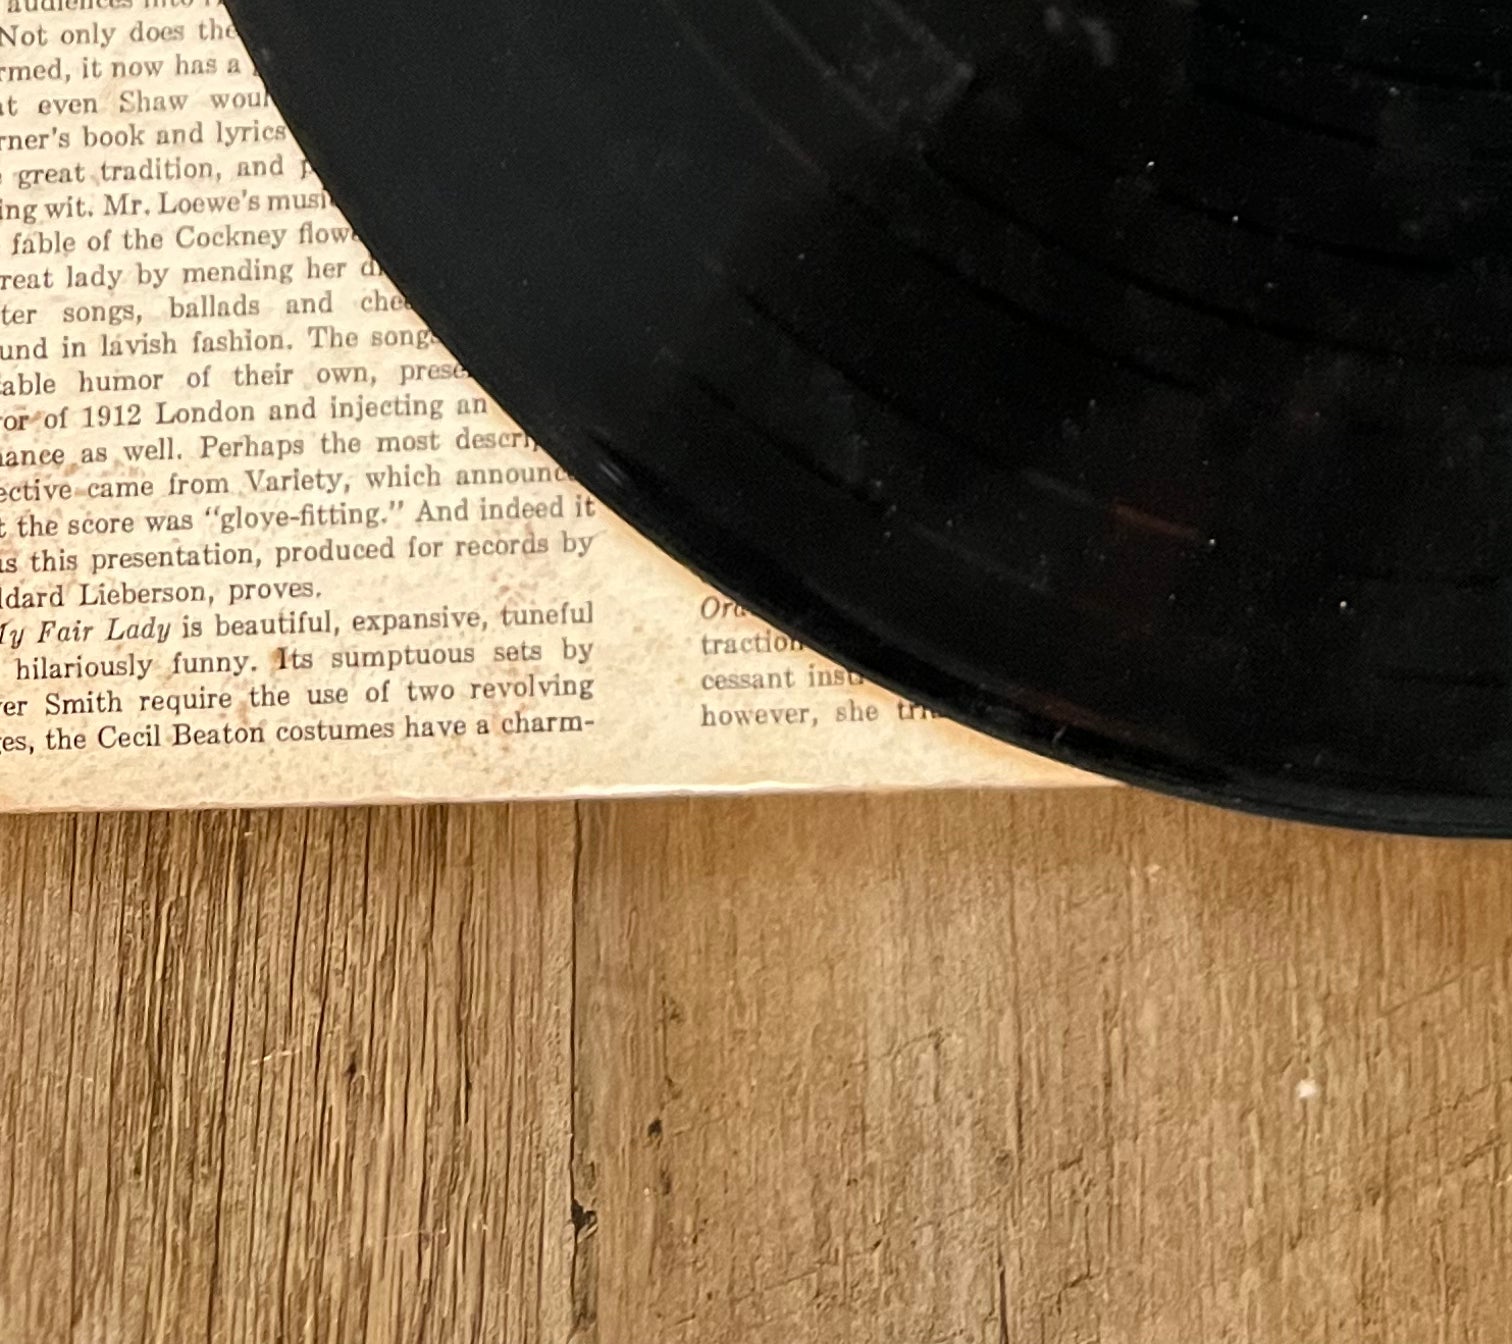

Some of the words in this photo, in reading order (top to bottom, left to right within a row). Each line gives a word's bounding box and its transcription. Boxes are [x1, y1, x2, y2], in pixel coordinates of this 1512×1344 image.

[60, 21, 116, 49] only
[129, 20, 184, 43] does
[37, 97, 98, 116] even
[119, 89, 188, 114] Shaw
[36, 619, 94, 644] Fair
[104, 615, 172, 644] Lady
[182, 621, 203, 639] is
[215, 609, 340, 637] beautiful,
[352, 611, 488, 636] expansive,
[499, 600, 593, 627] tuneful
[14, 652, 154, 681] hilariously
[172, 651, 257, 677] funny.
[277, 646, 313, 670] Its
[331, 645, 475, 672] sumptuous
[493, 641, 542, 662] sets
[561, 636, 593, 665] by
[700, 667, 796, 691] cessant
[700, 703, 818, 728] however,
[835, 698, 879, 722] she
[45, 727, 87, 751] the
[97, 723, 161, 750] Cecil
[171, 723, 265, 747] Beaton
[276, 719, 395, 742] costumes
[405, 714, 467, 738] have
[476, 719, 490, 735] a
